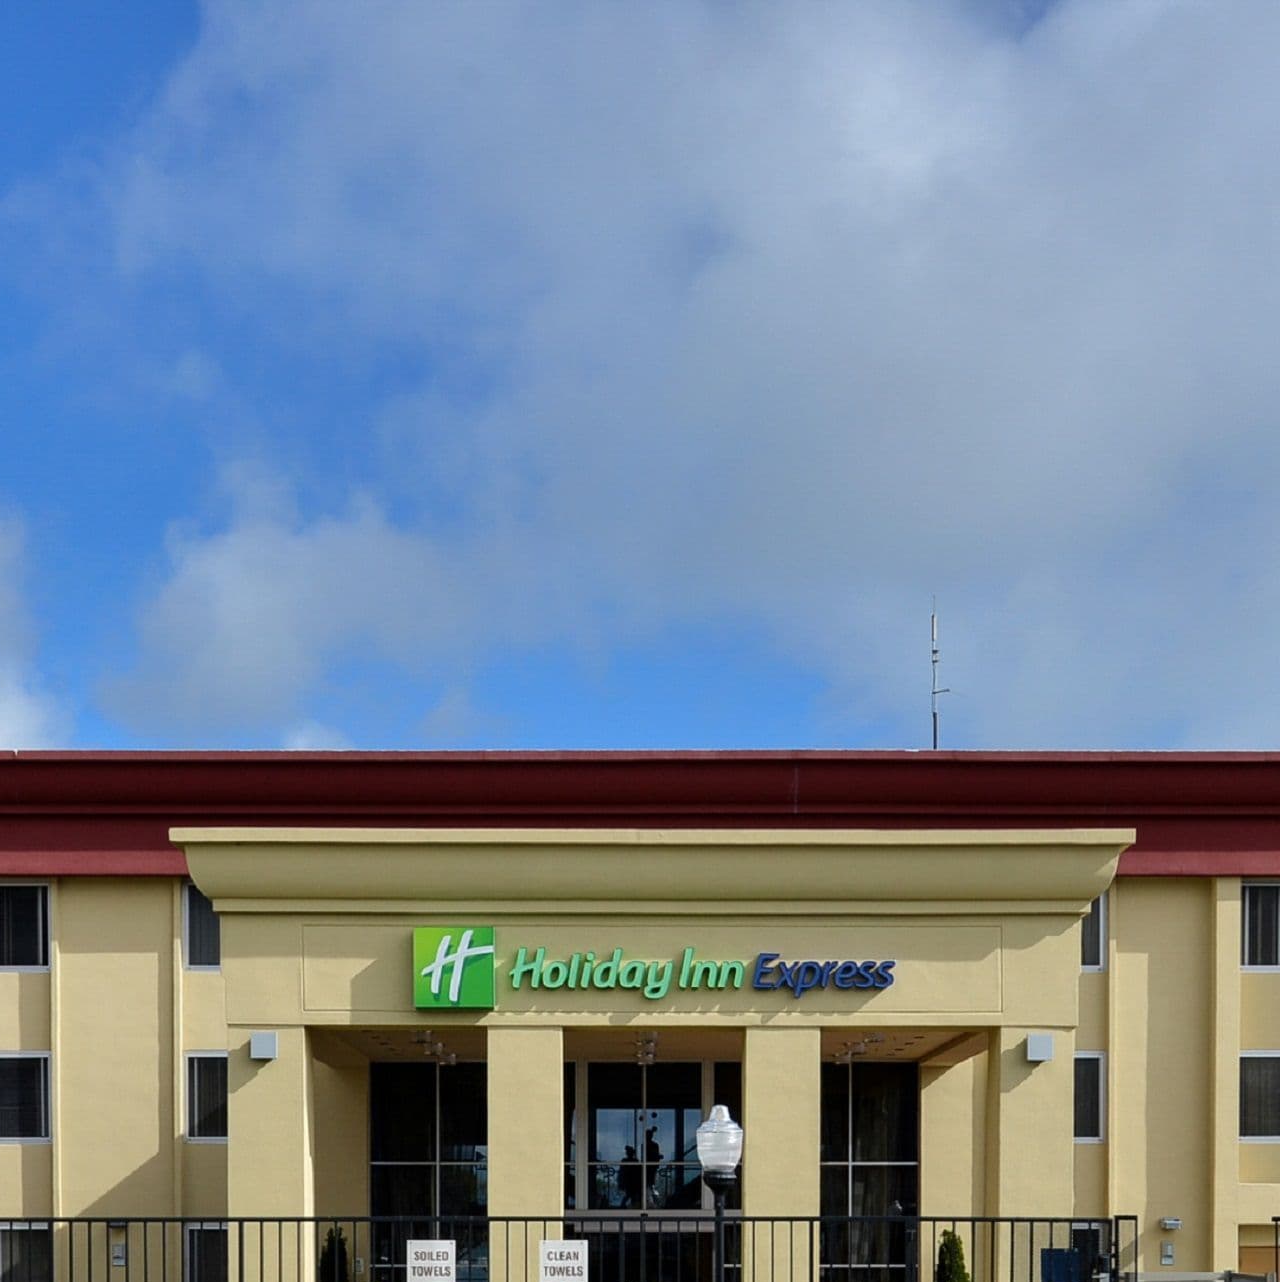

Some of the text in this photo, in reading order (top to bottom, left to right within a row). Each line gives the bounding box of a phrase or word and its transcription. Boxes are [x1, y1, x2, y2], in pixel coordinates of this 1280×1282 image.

[509, 946, 896, 1000] Holiday Inn Express
[414, 1251, 449, 1262] SOILED
[547, 1251, 579, 1262] CLEAN
[411, 1266, 451, 1277] TOWELS
[544, 1266, 584, 1277] TOWELS
